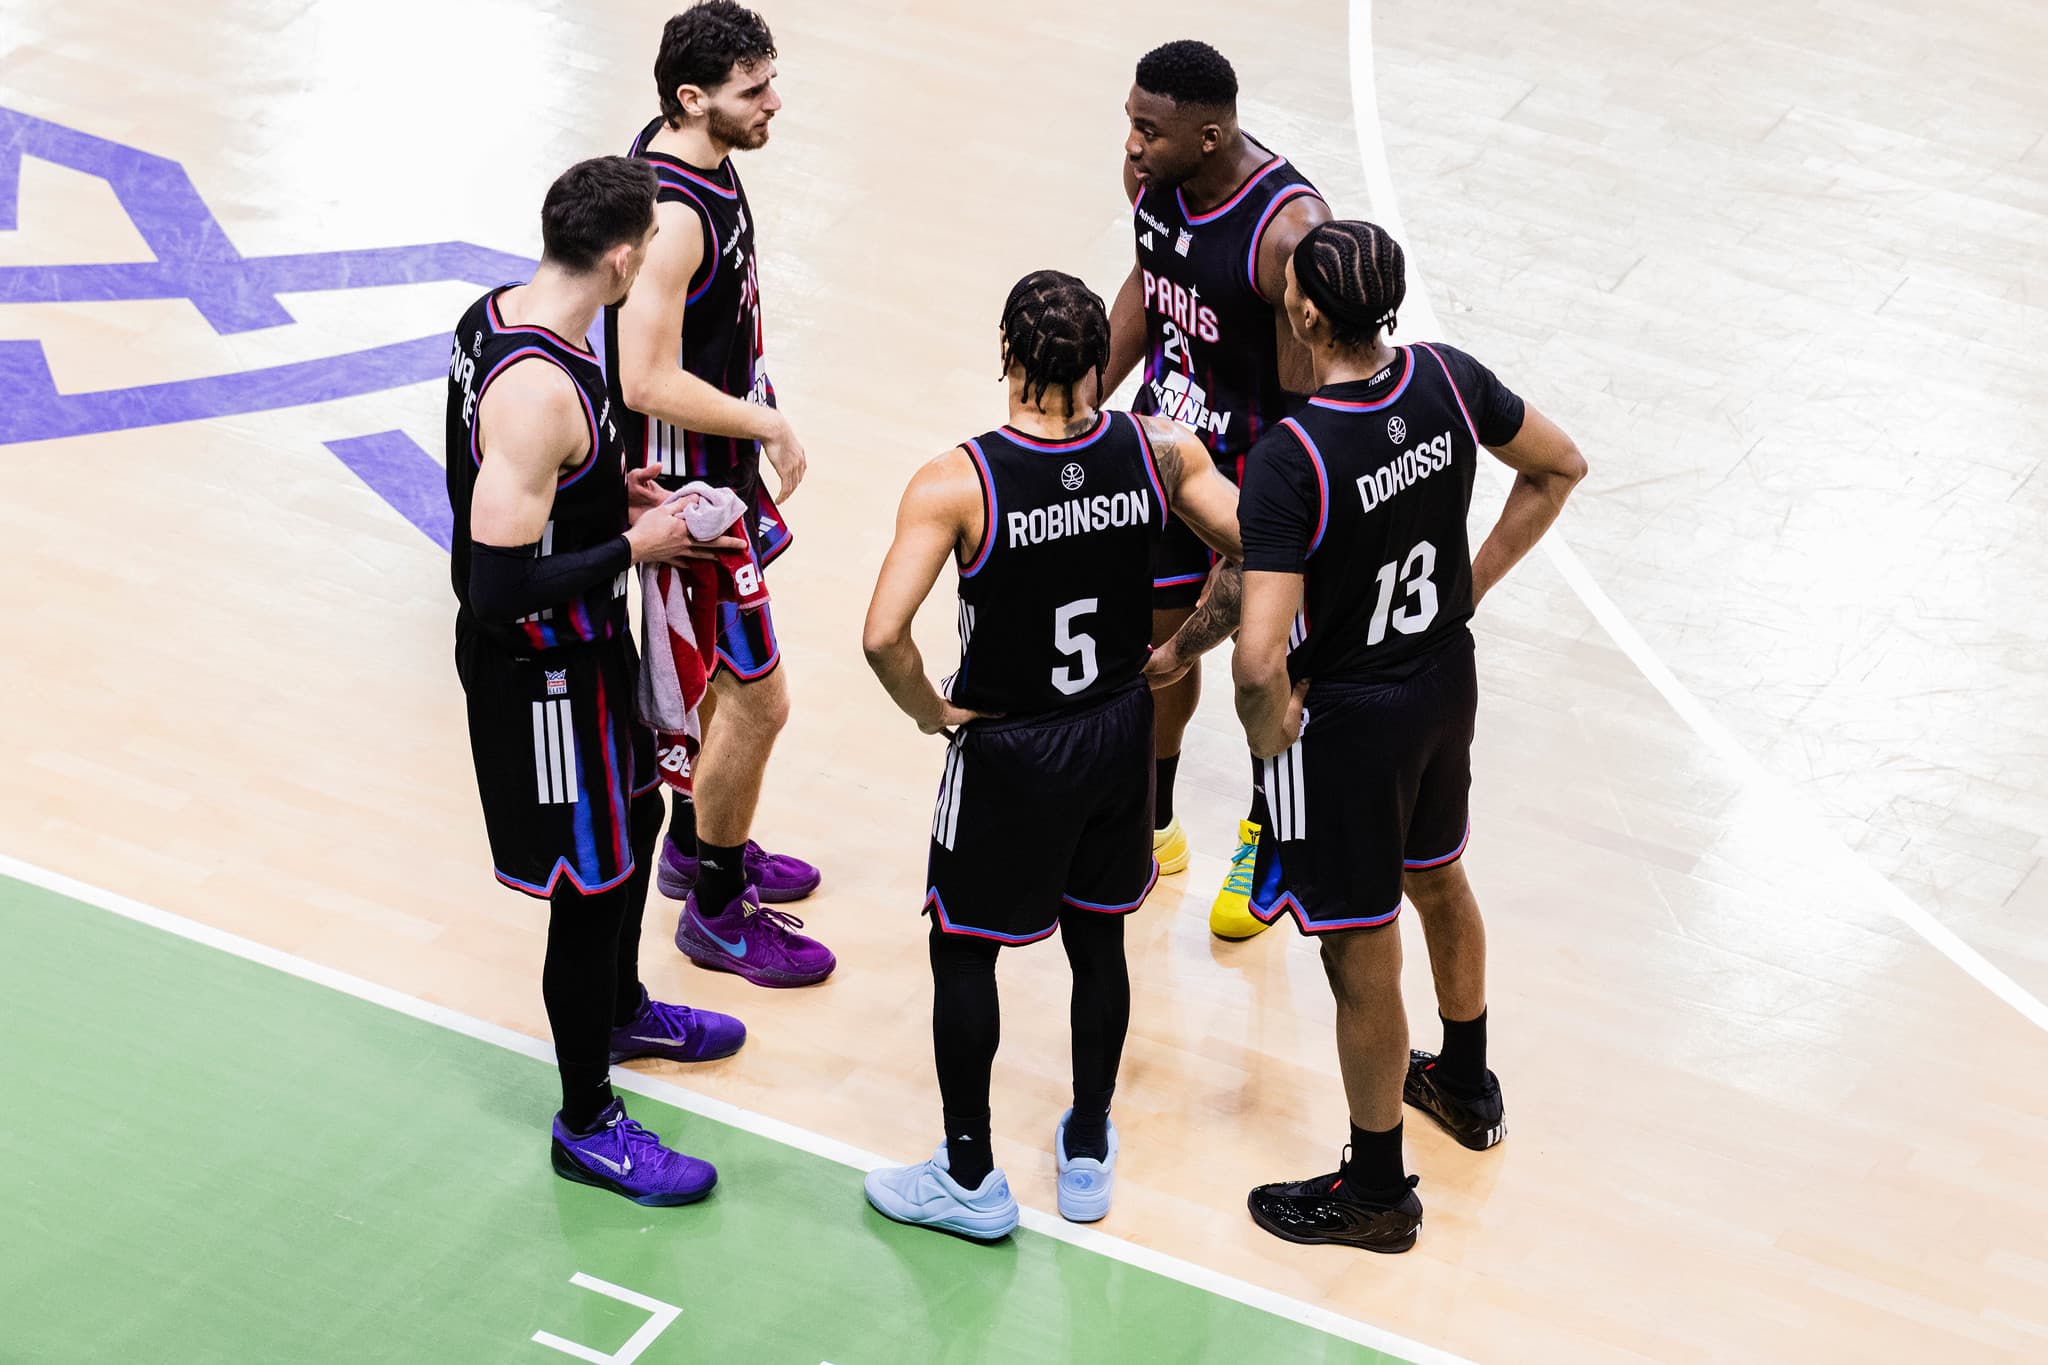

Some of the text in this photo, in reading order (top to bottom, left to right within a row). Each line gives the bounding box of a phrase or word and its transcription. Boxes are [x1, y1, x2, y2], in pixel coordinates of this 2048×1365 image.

[1142, 268, 1220, 343] PARIS
[1355, 431, 1452, 514] DOKOSSI
[1007, 488, 1150, 549] ROBINSON
[1366, 540, 1439, 646] 13
[1051, 597, 1099, 696] 5
